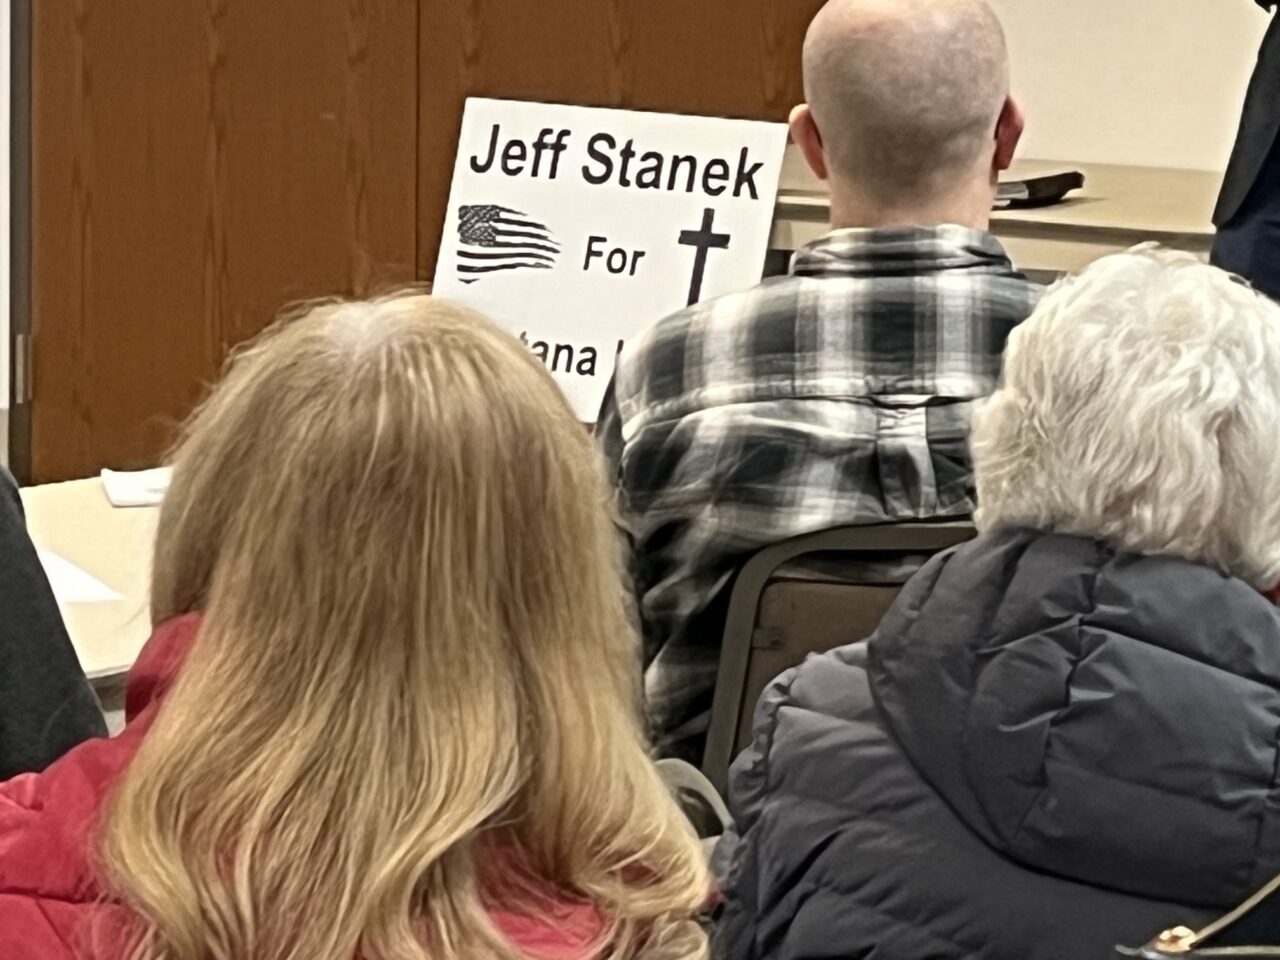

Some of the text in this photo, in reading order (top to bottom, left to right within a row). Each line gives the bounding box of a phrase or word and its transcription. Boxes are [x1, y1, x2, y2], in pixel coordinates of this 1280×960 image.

[469, 123, 764, 200] Jeff Stanek
[583, 235, 646, 276] For
